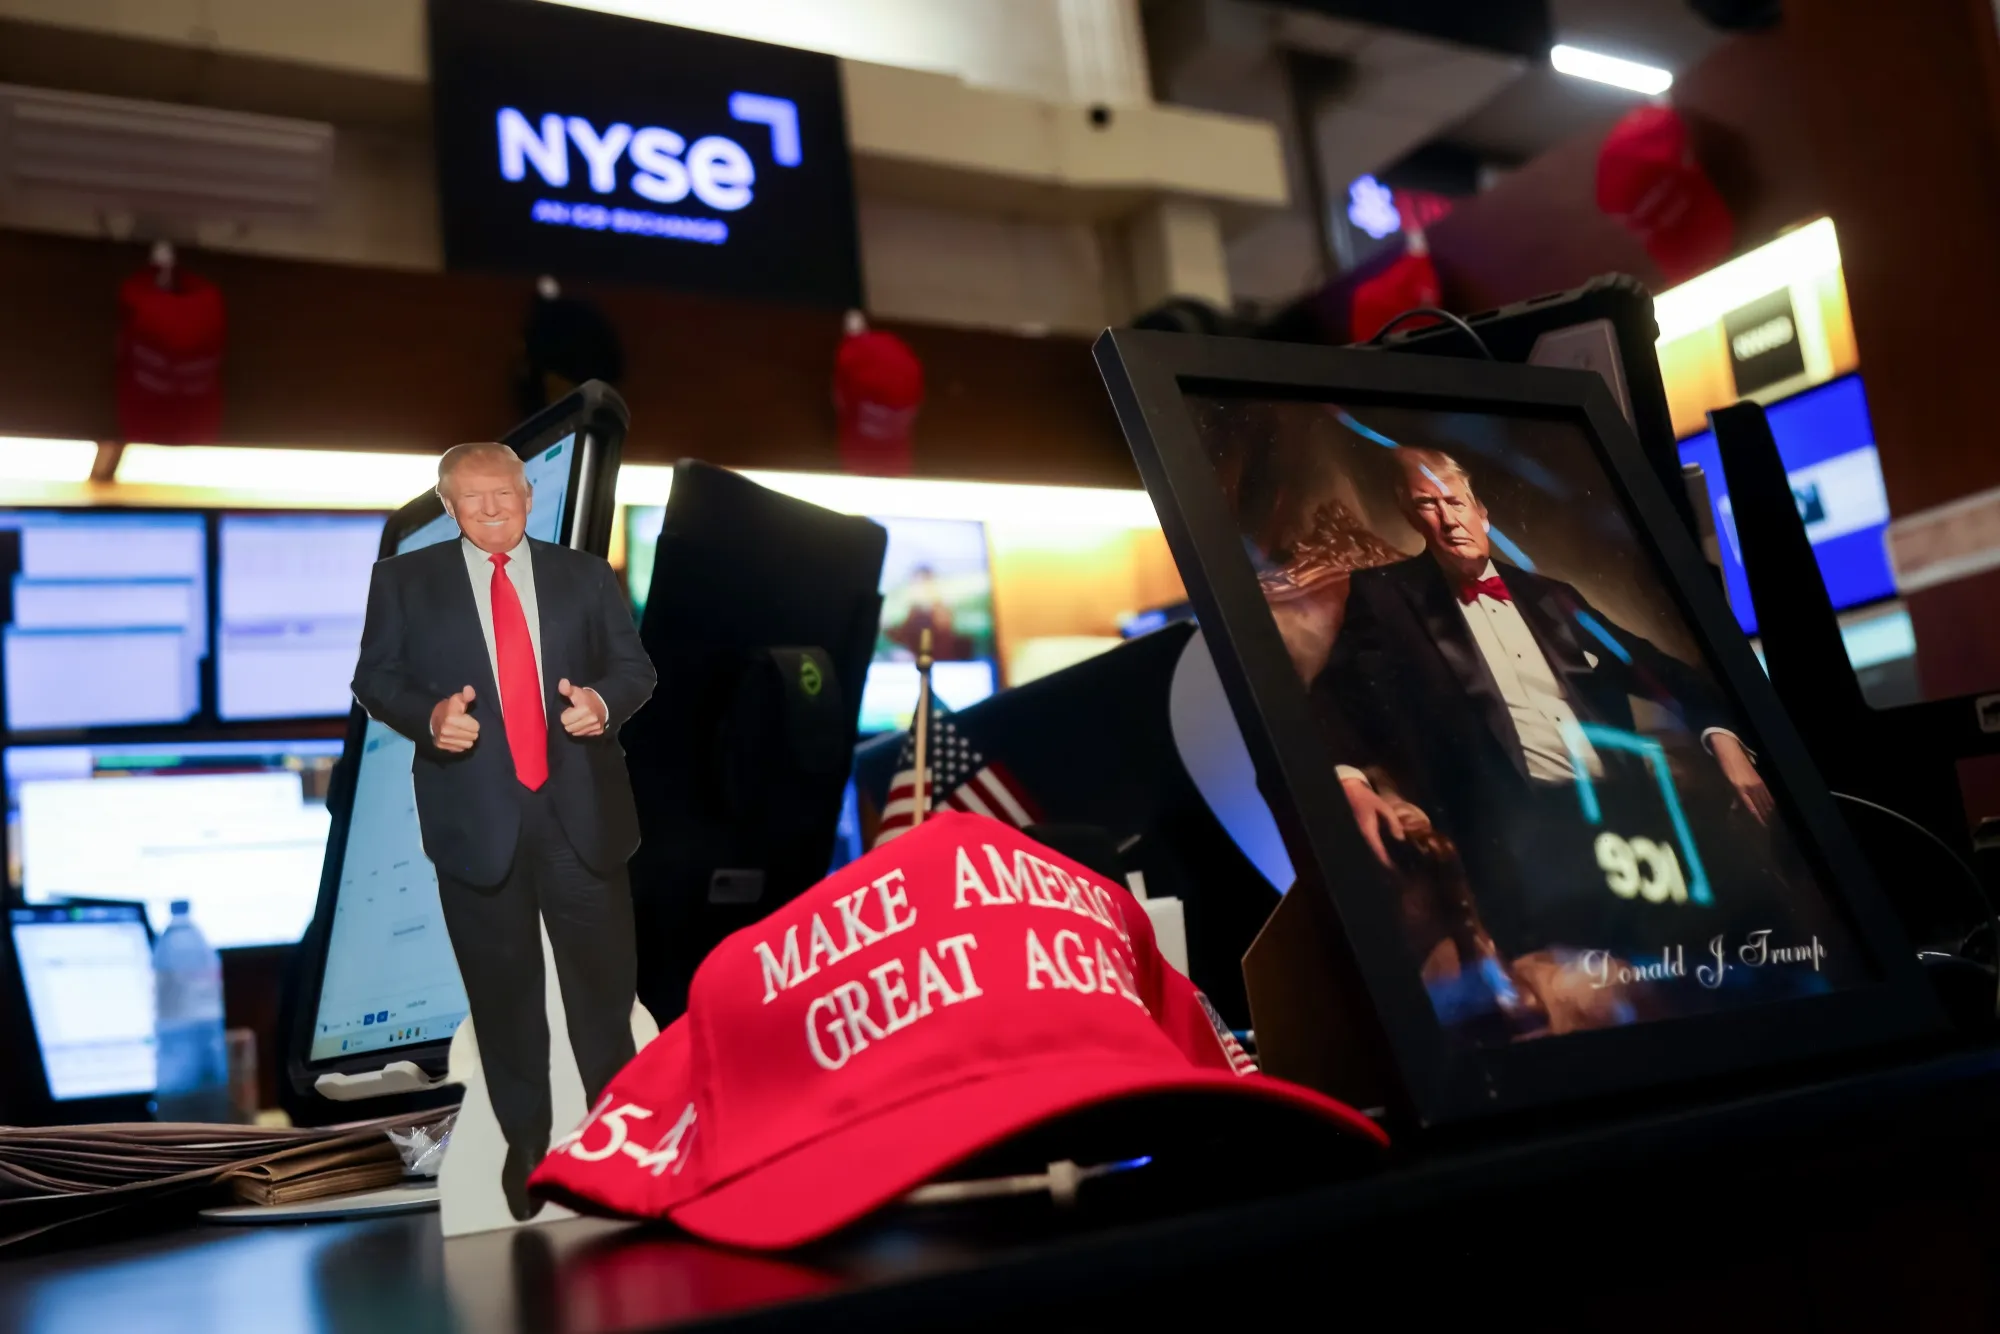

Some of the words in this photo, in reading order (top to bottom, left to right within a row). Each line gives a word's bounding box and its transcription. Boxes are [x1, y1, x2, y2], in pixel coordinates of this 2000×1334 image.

[753, 868, 917, 1004] MAKE
[954, 843, 1133, 950] AMERIC
[1580, 944, 1687, 990] Donald
[1696, 934, 1733, 989] J.
[1738, 929, 1827, 972] Trump
[805, 933, 983, 1070] GREAT
